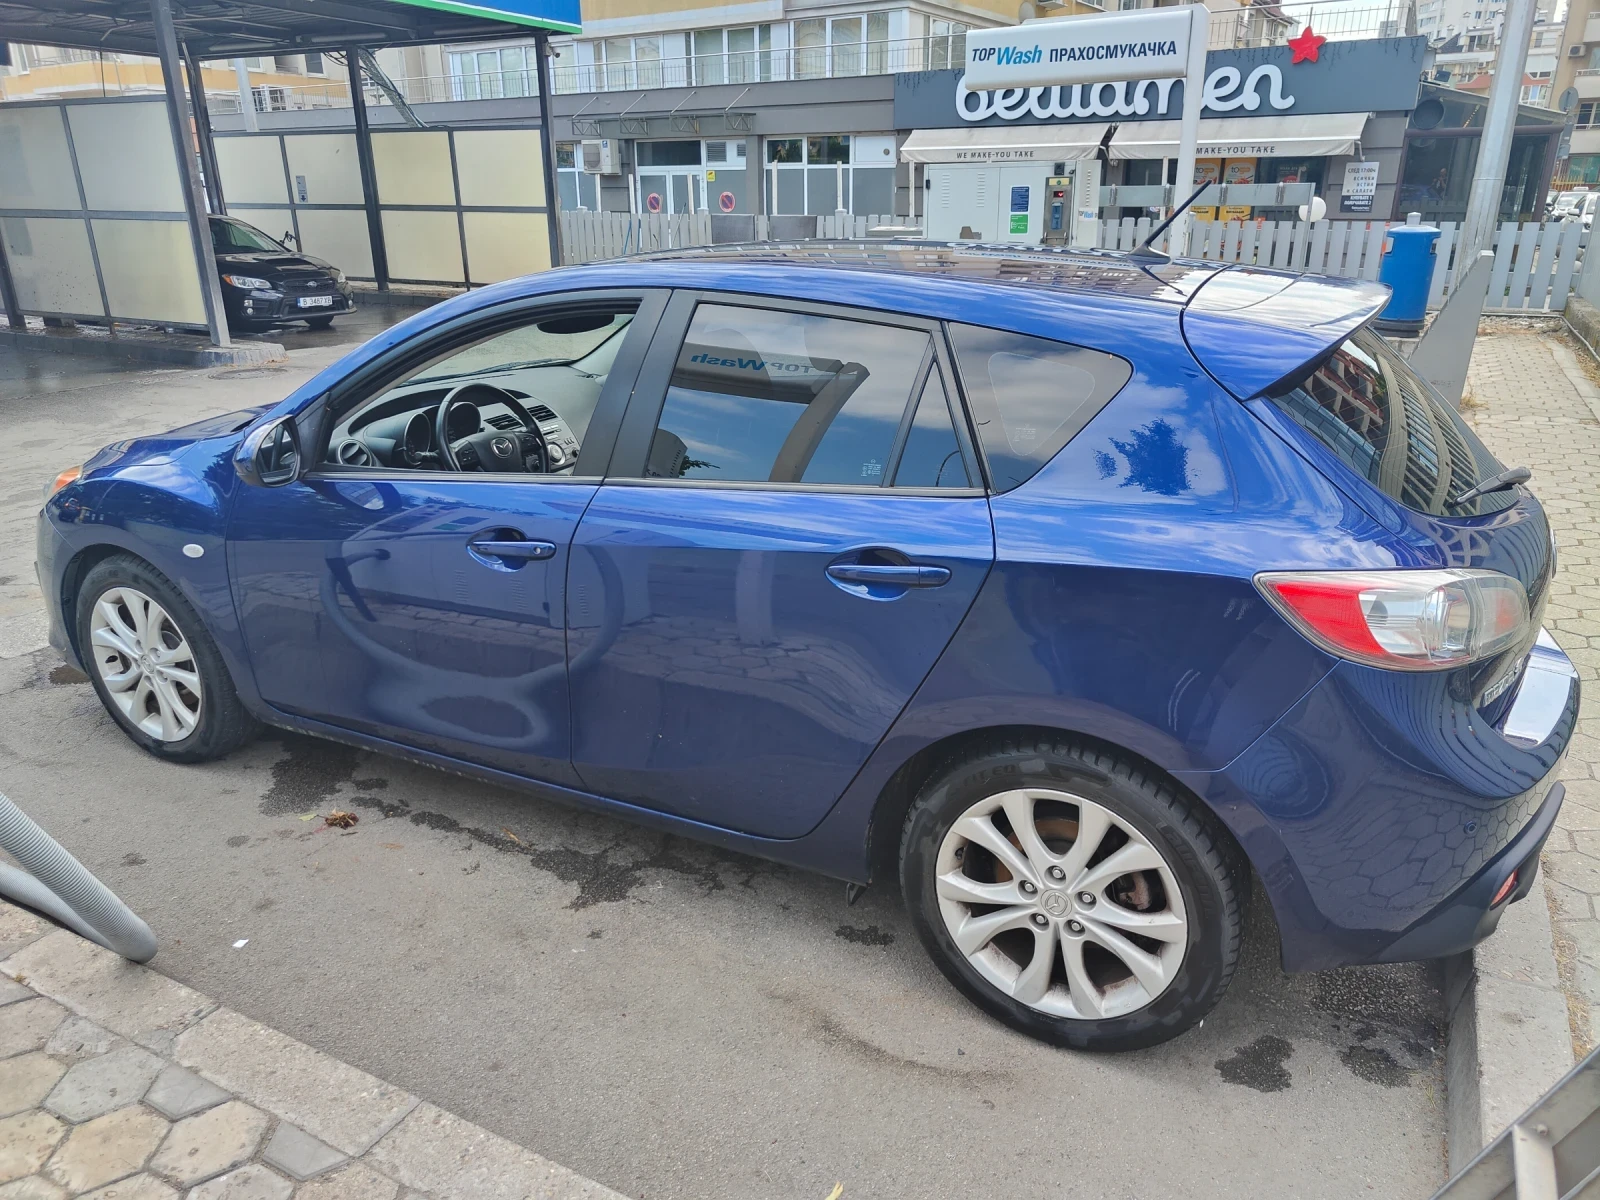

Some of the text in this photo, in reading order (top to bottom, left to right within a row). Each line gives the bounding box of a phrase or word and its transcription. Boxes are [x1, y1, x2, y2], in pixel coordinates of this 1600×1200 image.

[971, 45, 1043, 66] TOP Wash
[1049, 41, 1177, 63] ПРАХОСМУКАЧКА
[956, 150, 1035, 159] WE MAKE-YOU TAKE
[1195, 145, 1276, 155] MAKE-YOU TAKE
